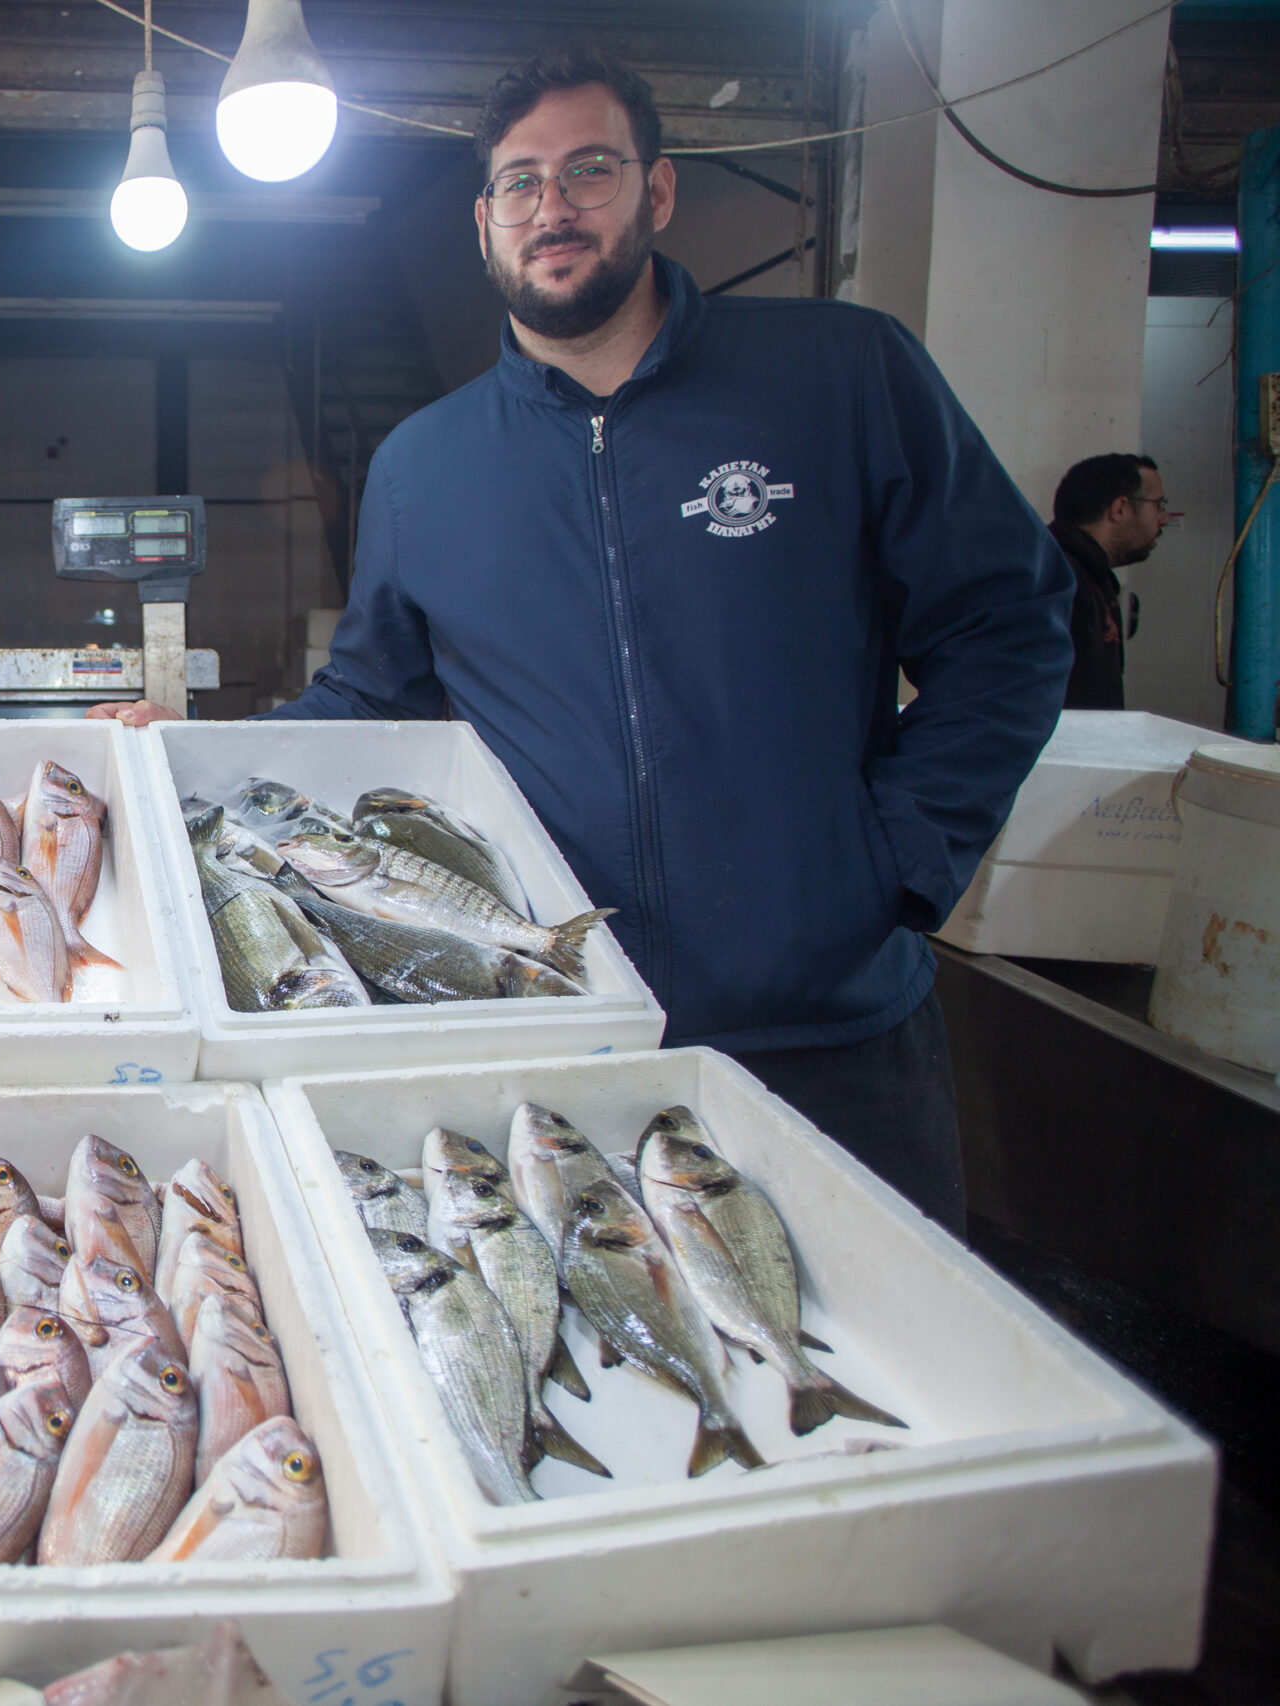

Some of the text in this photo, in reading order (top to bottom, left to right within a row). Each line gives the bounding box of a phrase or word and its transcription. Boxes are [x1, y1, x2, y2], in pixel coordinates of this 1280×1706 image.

[698, 460, 770, 490] ΚΑΠΕΤΑΝ
[686, 487, 791, 513] fish trade
[706, 512, 777, 537] ΠΑΝΑΓΗΣ
